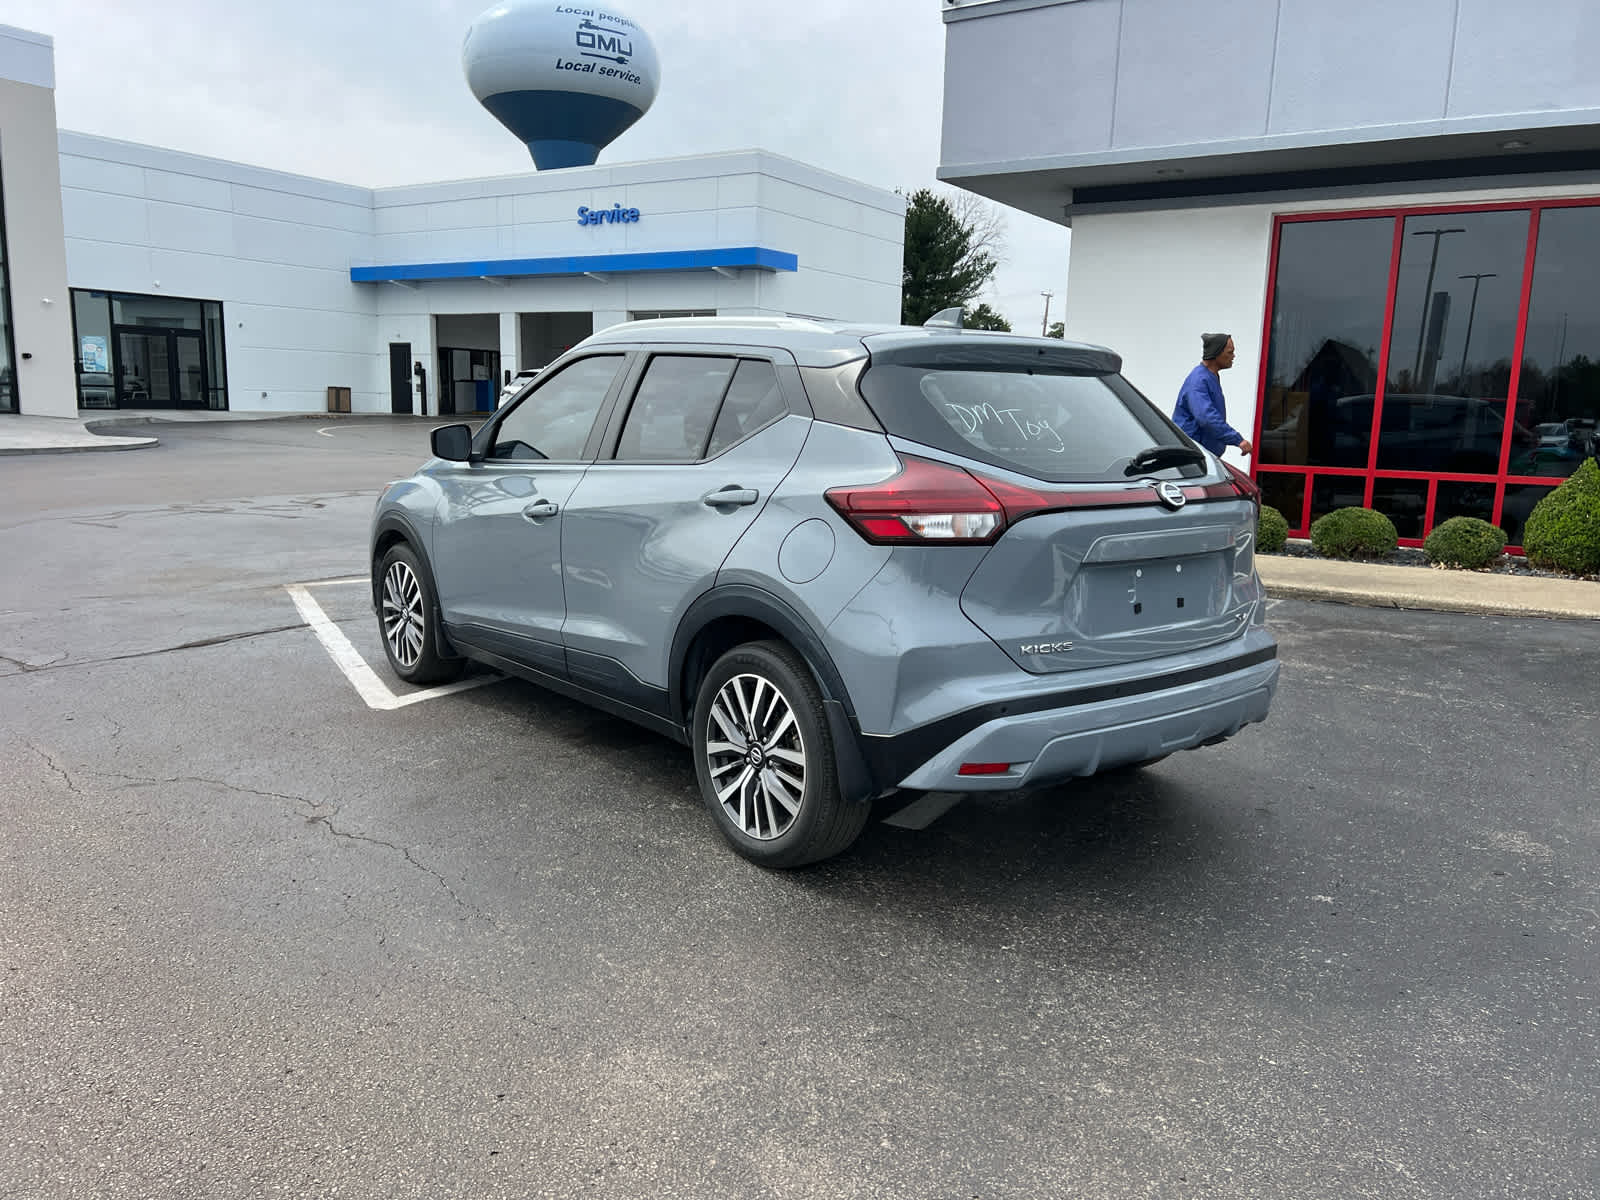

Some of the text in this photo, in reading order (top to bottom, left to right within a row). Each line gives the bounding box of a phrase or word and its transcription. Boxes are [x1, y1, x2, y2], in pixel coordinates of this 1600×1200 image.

[555, 6, 594, 17] Local
[576, 31, 632, 57] OMU
[555, 58, 641, 85] Local service.
[577, 202, 640, 226] Service
[1020, 641, 1073, 656] KICKS
